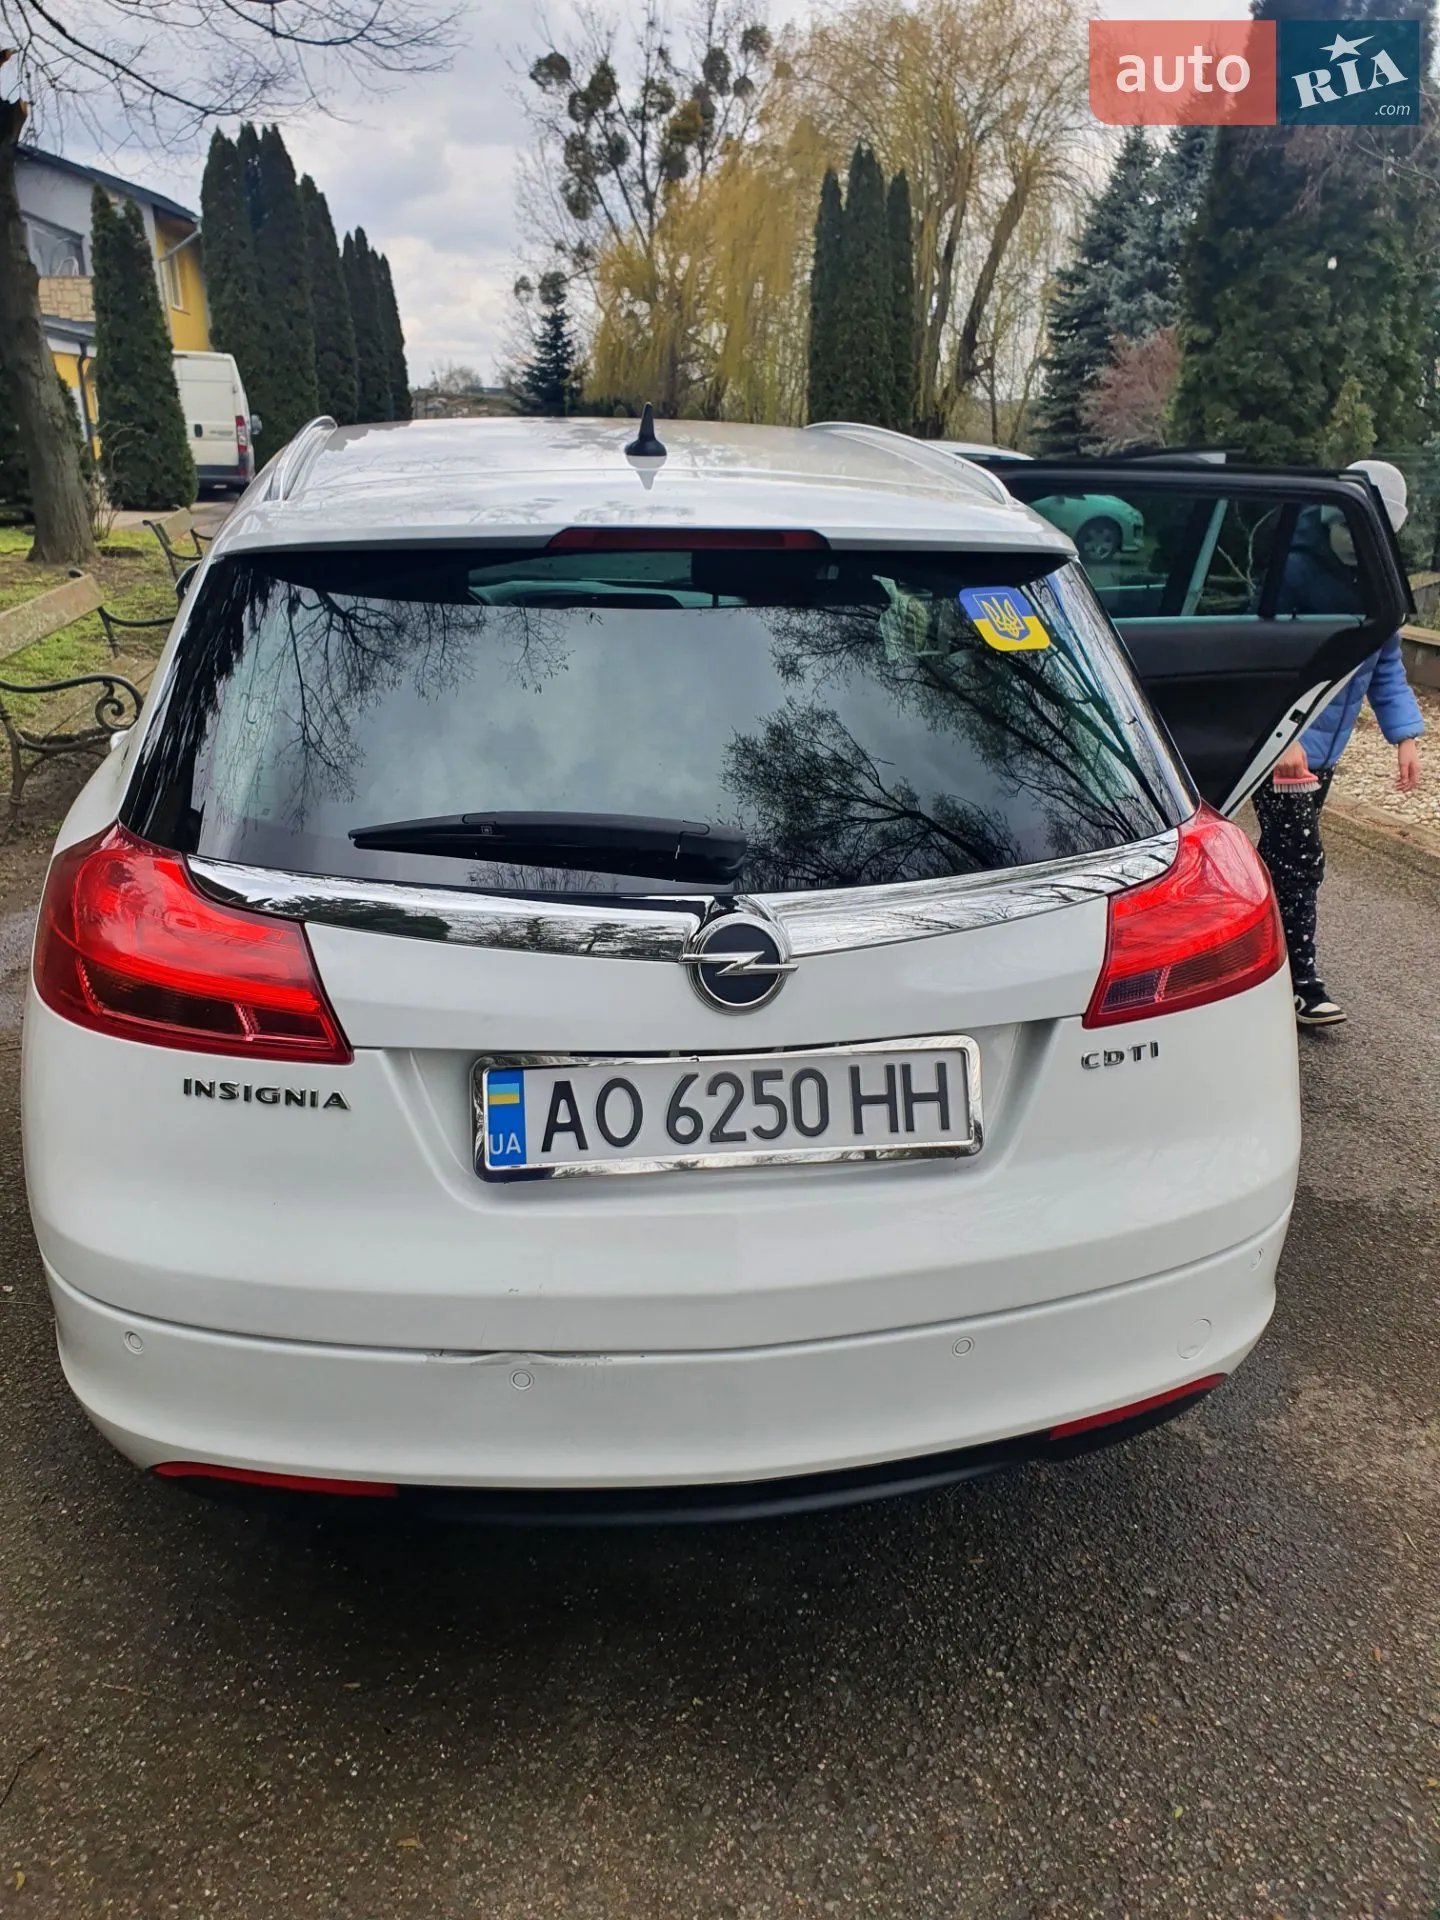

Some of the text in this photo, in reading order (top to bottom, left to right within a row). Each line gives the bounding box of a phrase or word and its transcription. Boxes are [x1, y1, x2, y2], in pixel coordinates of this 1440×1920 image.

[1081, 1041, 1159, 1070] CDTI
[183, 1076, 352, 1110] INSIGNIA
[541, 1062, 951, 1153] AO 6250 HH
[489, 1132, 522, 1155] UA
